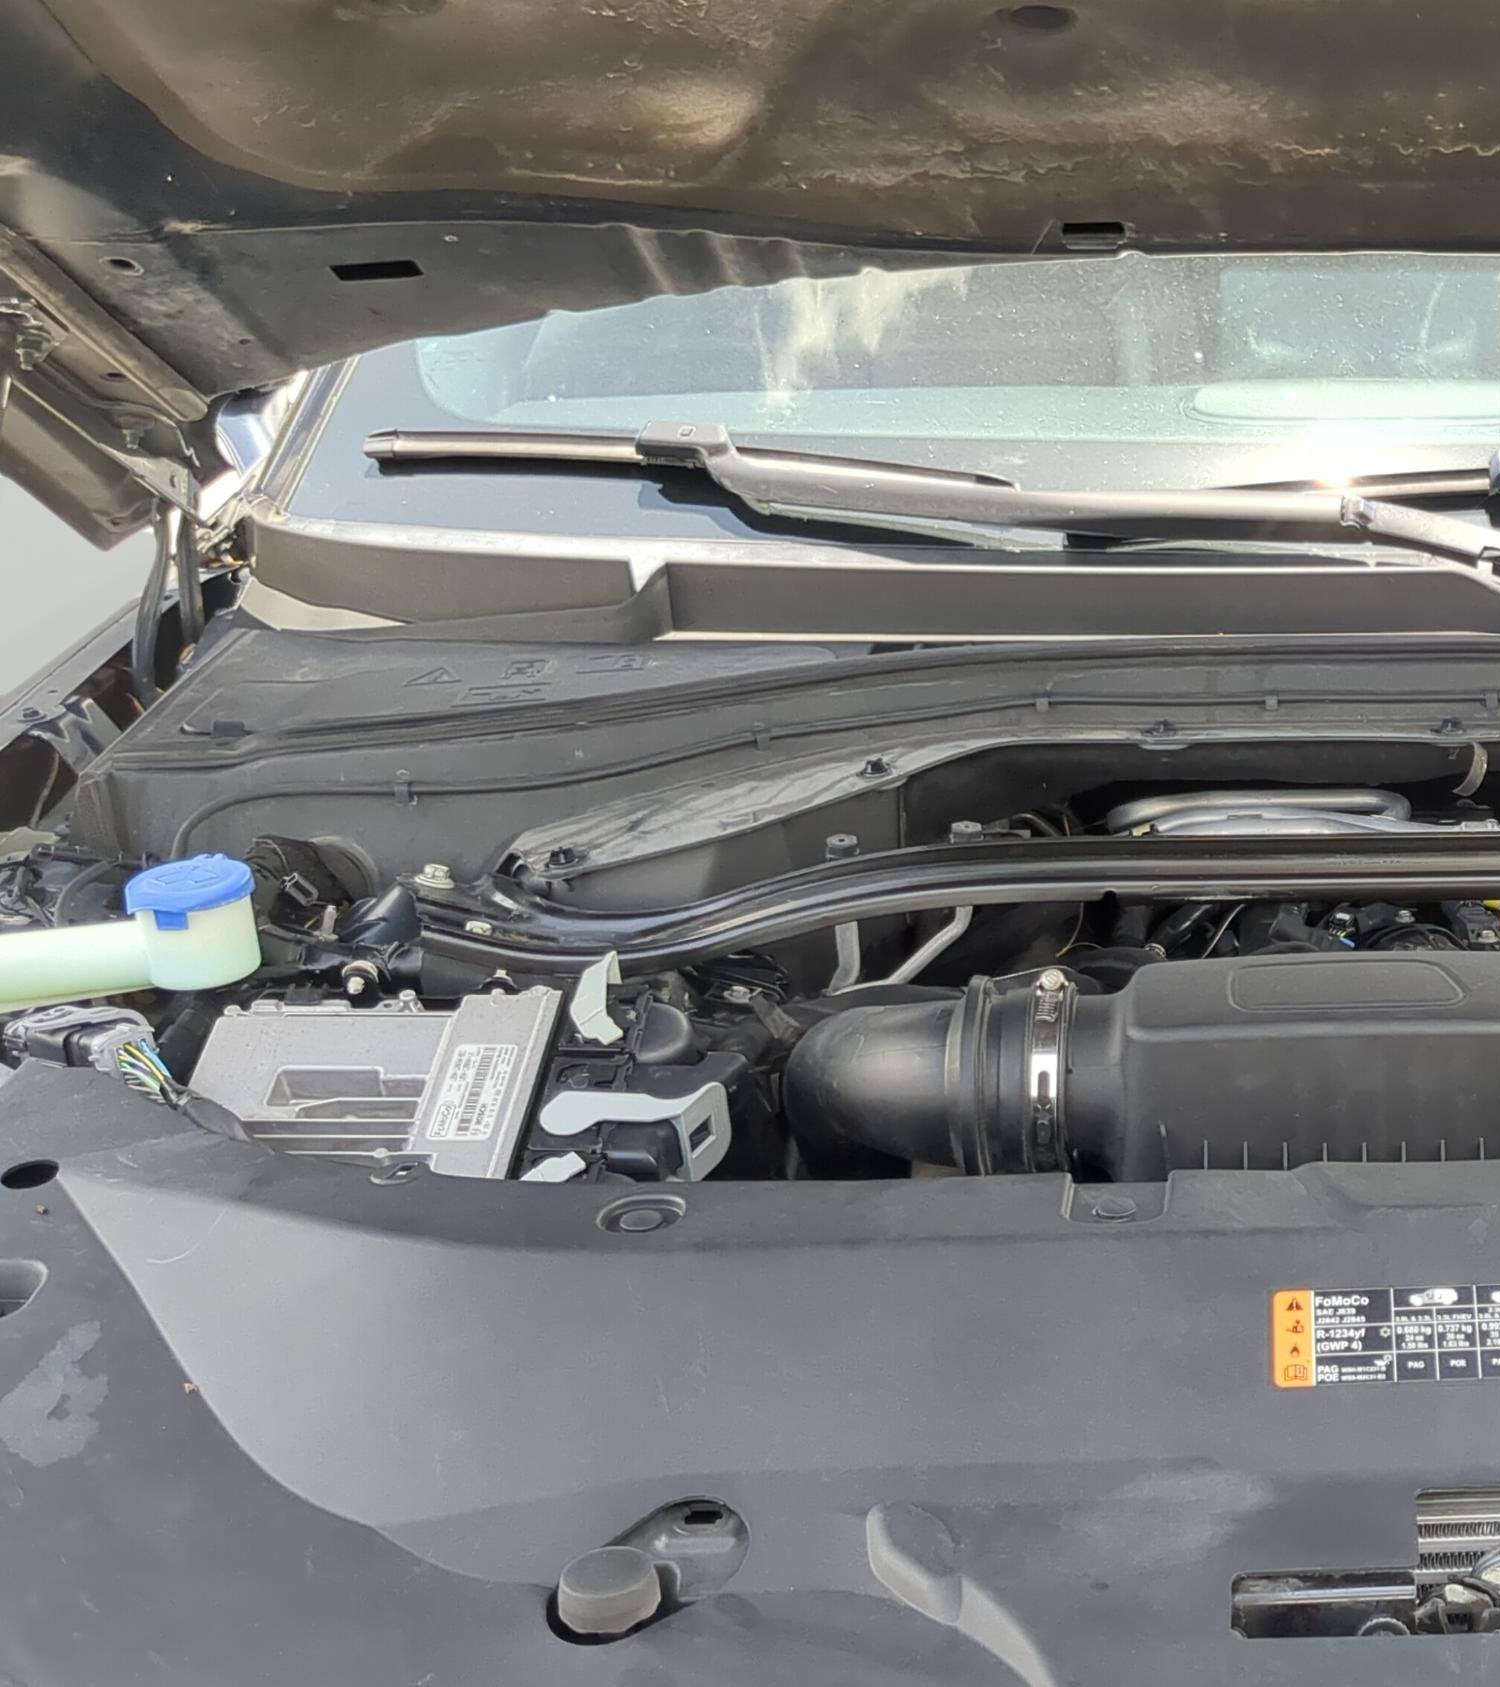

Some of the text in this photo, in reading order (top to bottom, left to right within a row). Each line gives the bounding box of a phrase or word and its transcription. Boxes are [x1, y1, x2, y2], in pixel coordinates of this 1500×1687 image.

[1315, 1294, 1370, 1307] FoMoCo
[1316, 1308, 1334, 1316] SAE
[1316, 1327, 1366, 1339] R-1234yf
[1420, 1325, 1432, 1336] kg
[1437, 1323, 1473, 1334] 0.737 kg
[1316, 1340, 1363, 1353] (GWP 4)
[1407, 1360, 1425, 1369] PAG
[1449, 1359, 1467, 1367] POE
[1317, 1365, 1339, 1374] PAG
[1317, 1373, 1339, 1382] POE
